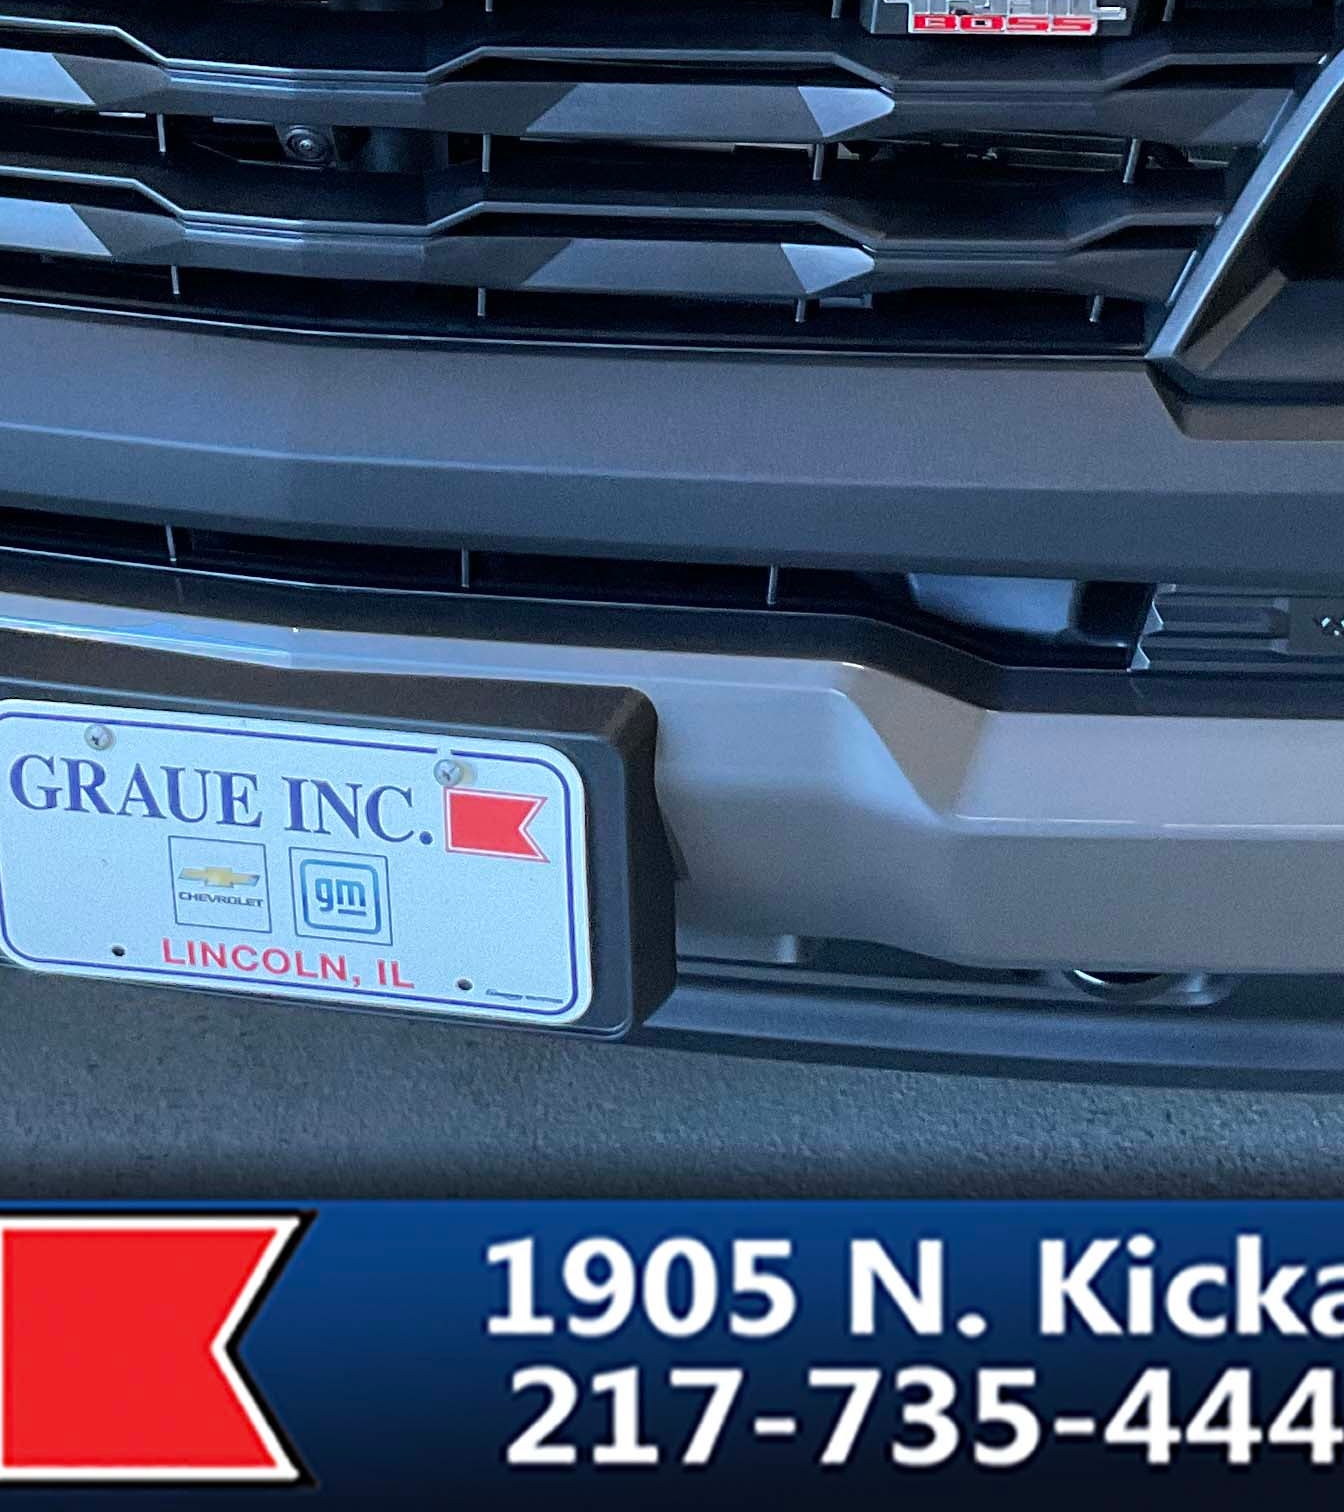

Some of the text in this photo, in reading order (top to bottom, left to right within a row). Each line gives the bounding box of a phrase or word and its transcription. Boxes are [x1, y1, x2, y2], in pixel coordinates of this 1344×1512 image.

[908, 13, 1098, 36] BOSS
[8, 753, 435, 846] GRAUE INC.
[177, 890, 265, 909] CHEVROLET
[313, 877, 368, 914] gm
[161, 937, 416, 989] LINCOLN, IL
